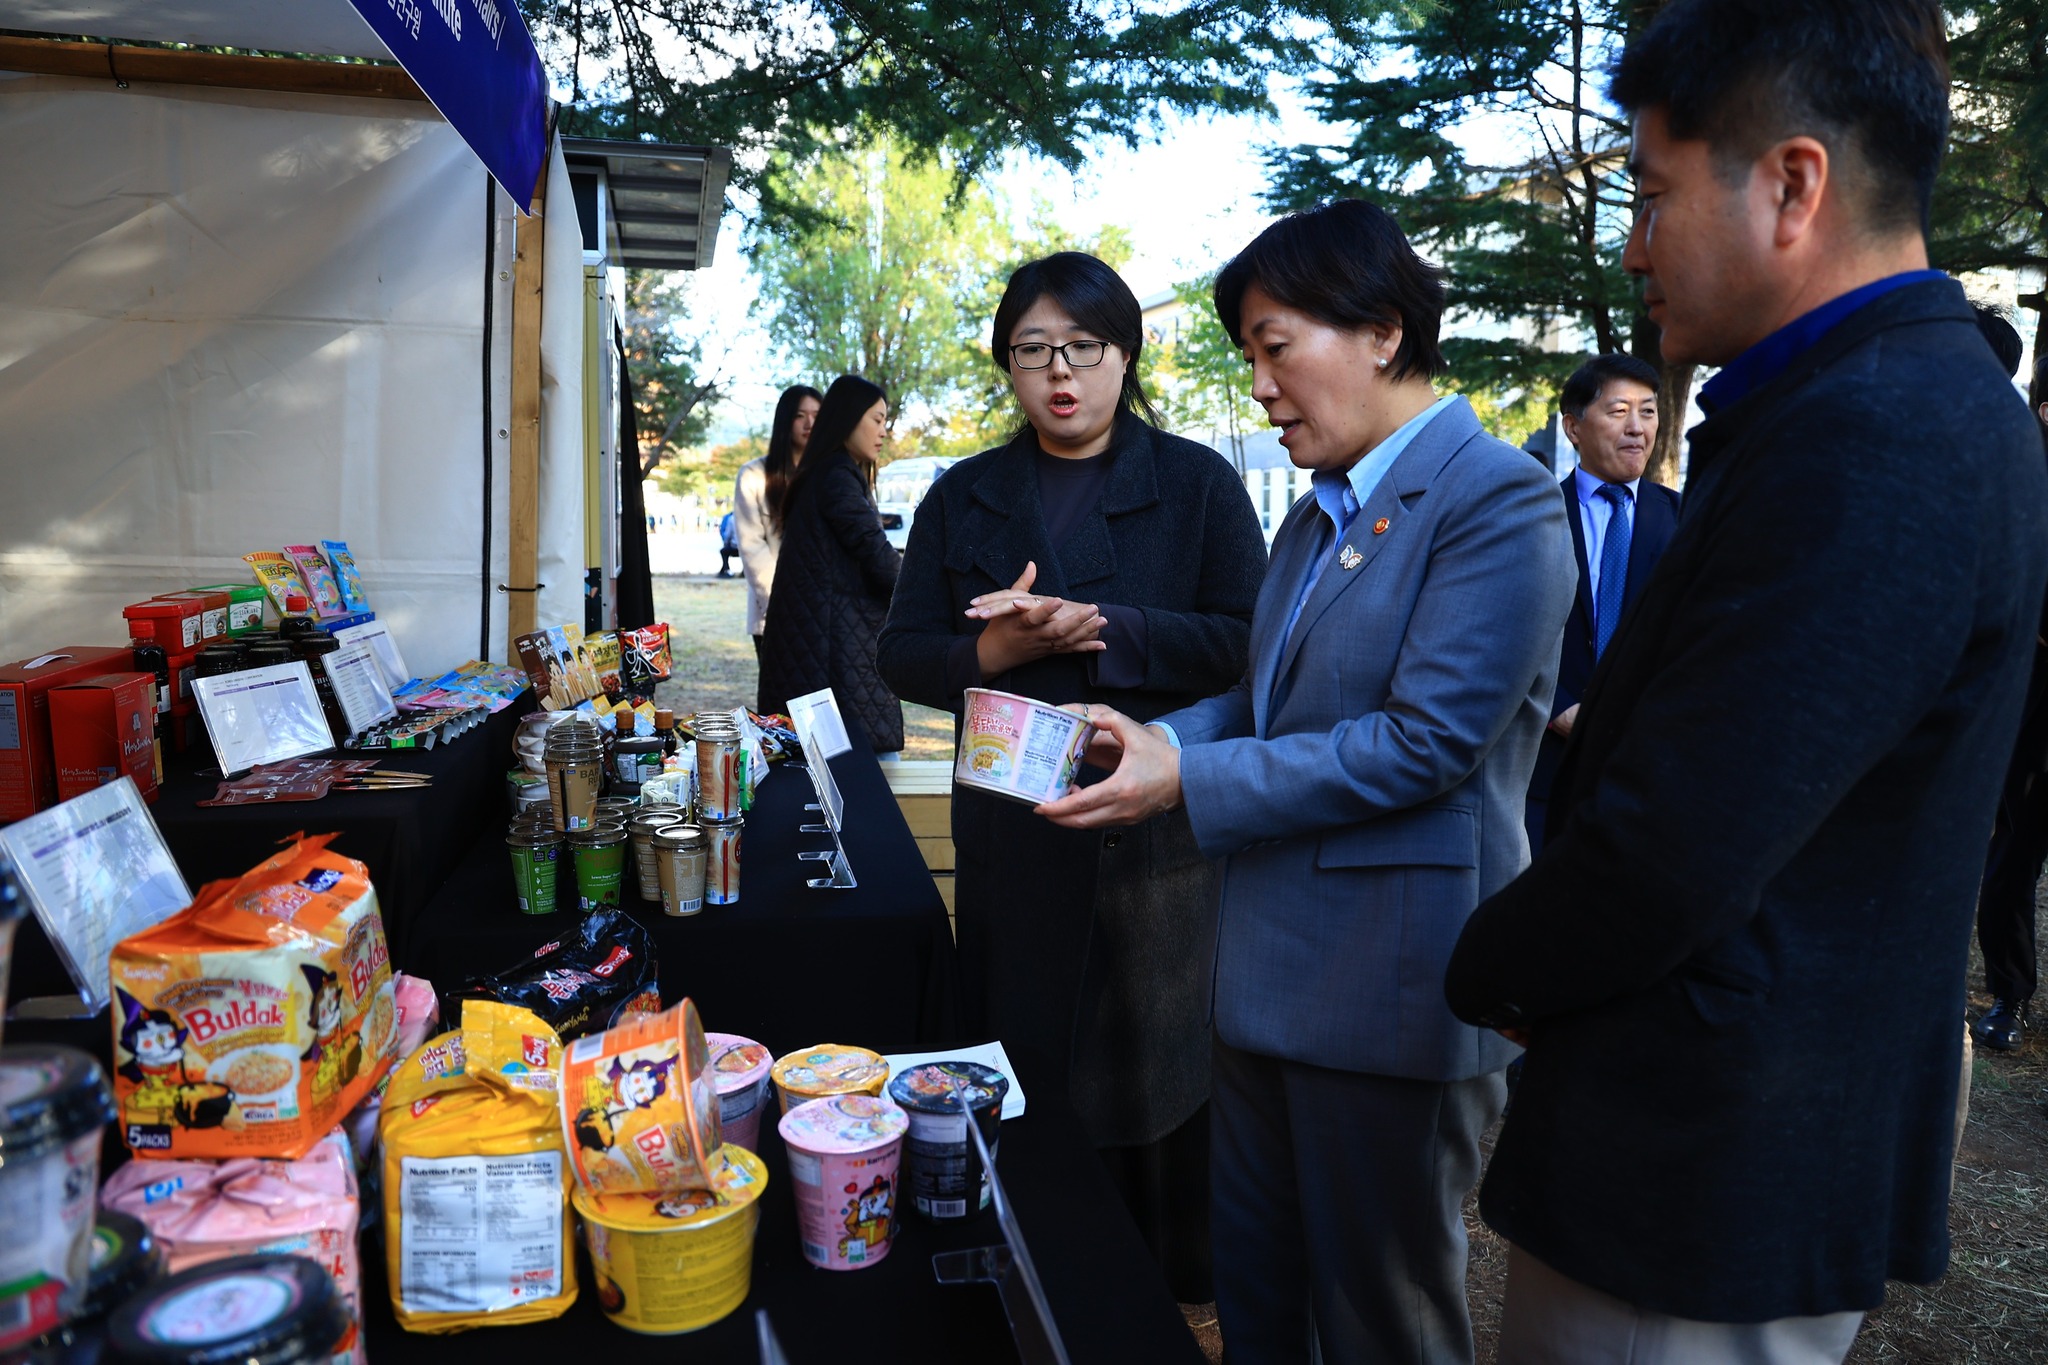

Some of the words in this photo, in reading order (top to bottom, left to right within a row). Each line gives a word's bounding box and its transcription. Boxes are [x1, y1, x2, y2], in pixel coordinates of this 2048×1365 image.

[350, 938, 388, 1002] Buldak
[183, 1001, 285, 1043] Buldak
[128, 1126, 171, 1148] 5PACKS
[410, 1167, 449, 1177] Nutrition
[451, 1167, 477, 1175] Facts
[486, 1162, 524, 1170] Nutrition
